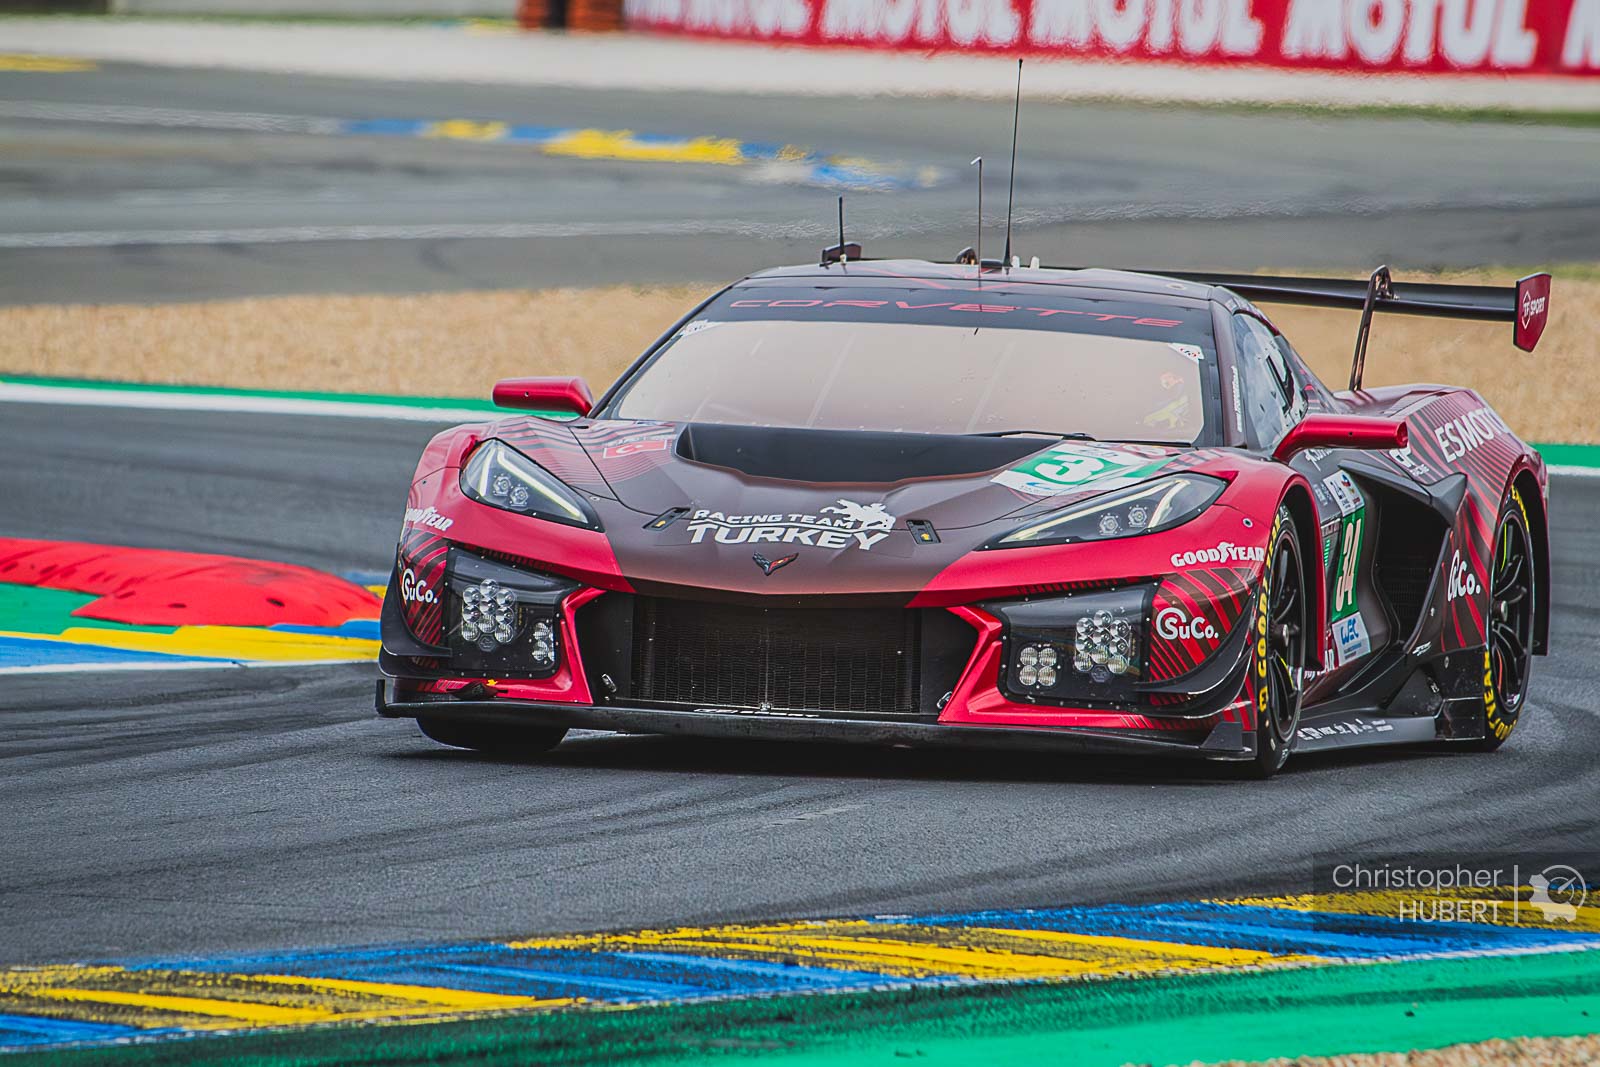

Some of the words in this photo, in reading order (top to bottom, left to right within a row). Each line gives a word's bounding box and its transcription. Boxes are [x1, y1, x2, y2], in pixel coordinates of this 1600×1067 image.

[730, 299, 1183, 328] CORVETTE
[693, 509, 783, 525] RACING
[788, 513, 853, 529] TEAM
[686, 523, 889, 551] TURKEY
[1171, 542, 1265, 567] GOODYEAR
